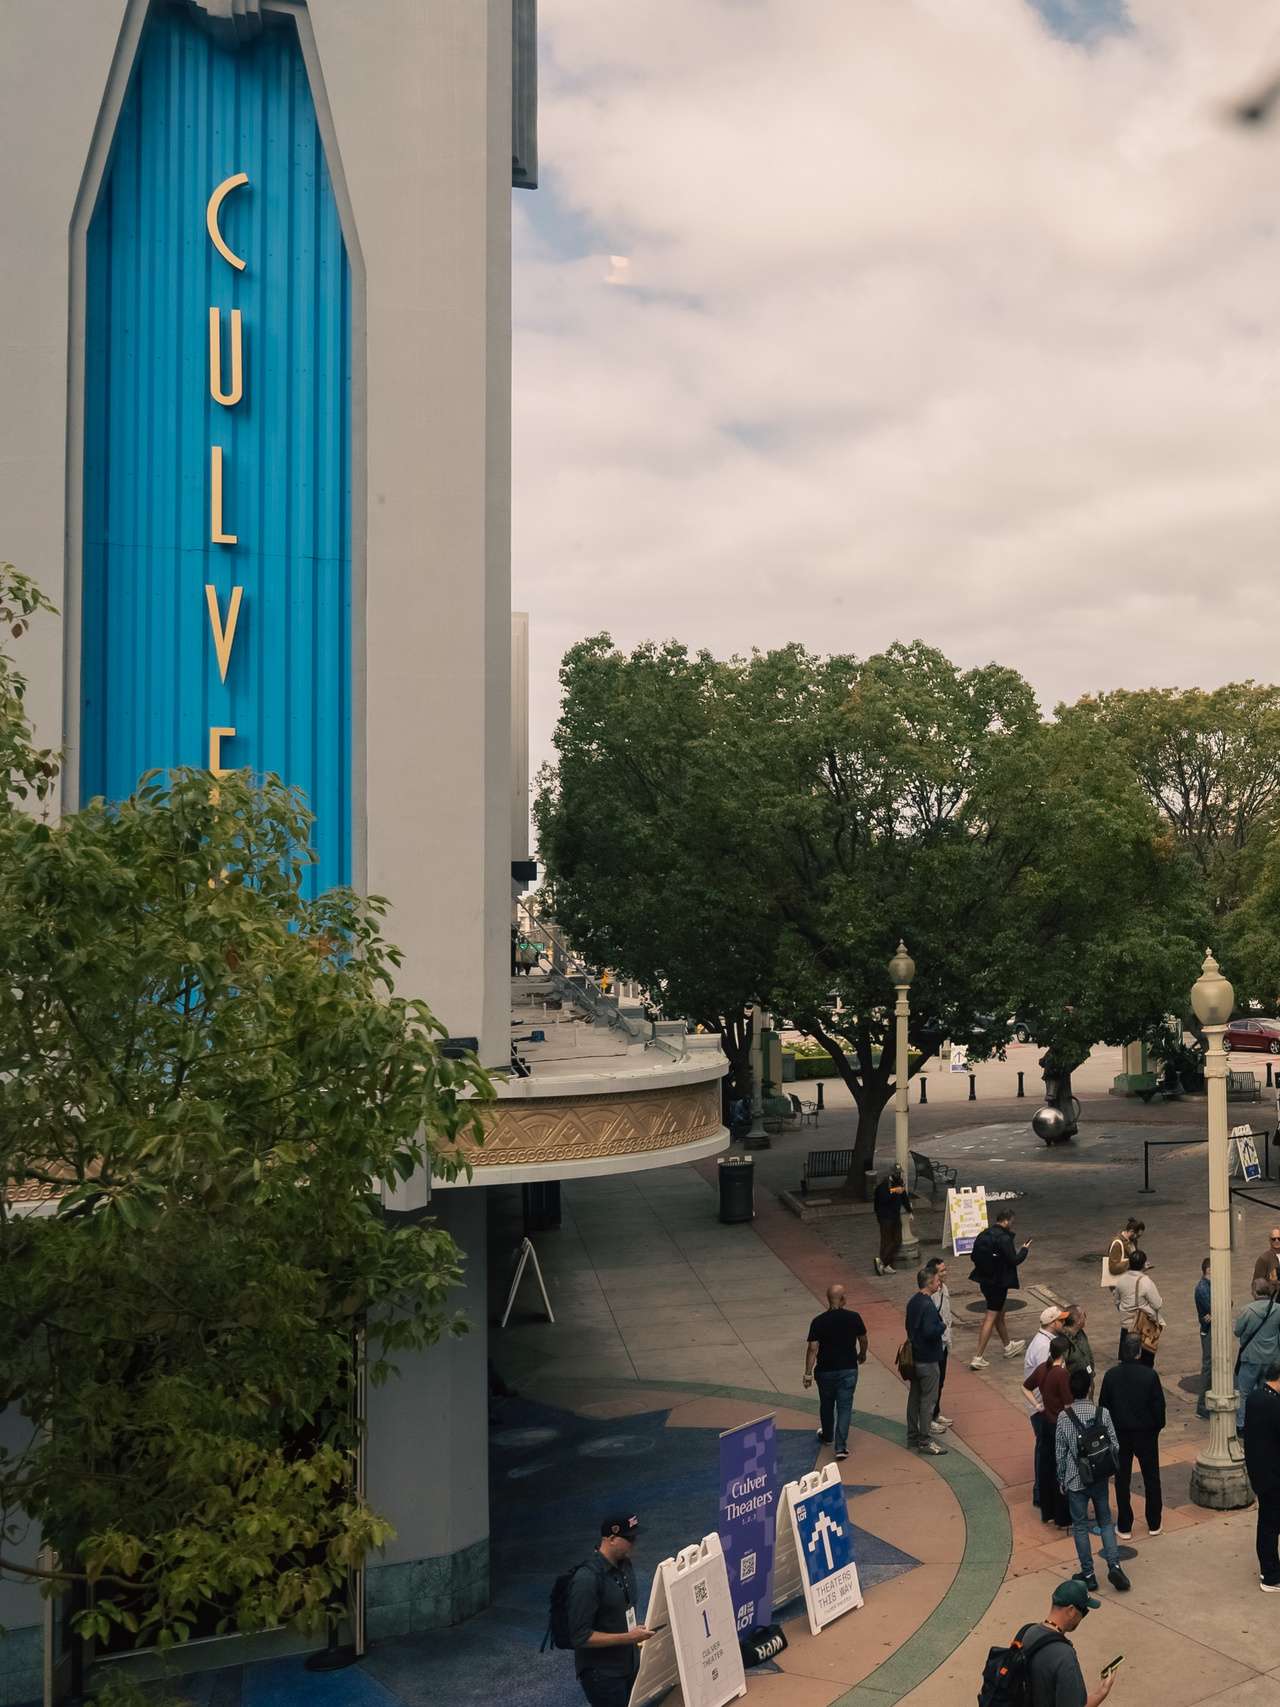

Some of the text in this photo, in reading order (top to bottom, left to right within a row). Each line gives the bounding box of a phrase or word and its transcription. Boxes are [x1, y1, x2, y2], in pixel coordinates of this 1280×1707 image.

[731, 1473, 767, 1499] Culver
[725, 1491, 773, 1521] Theaters
[816, 1570, 852, 1597] THEATERS
[818, 1581, 853, 1609] THIS WAY
[737, 1612, 754, 1631] LOT
[702, 1641, 721, 1658] CULVER
[702, 1649, 724, 1668] THEATER
[755, 1635, 784, 1660] WPR
